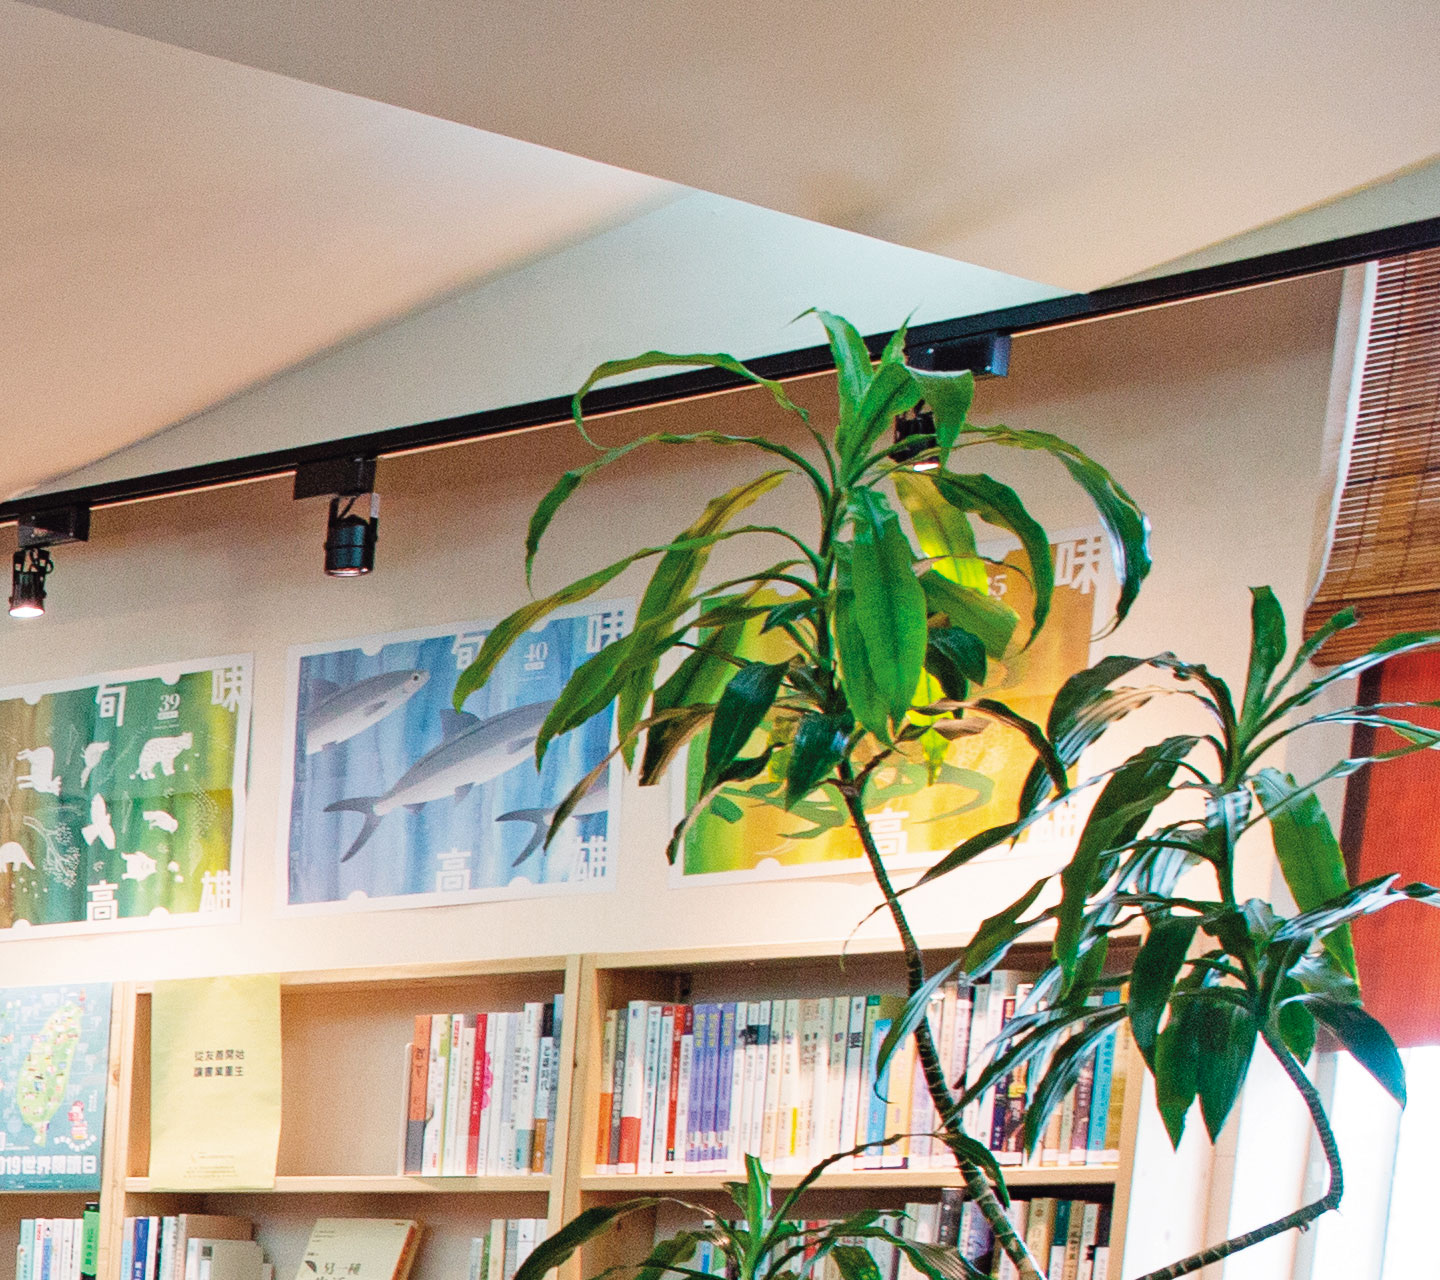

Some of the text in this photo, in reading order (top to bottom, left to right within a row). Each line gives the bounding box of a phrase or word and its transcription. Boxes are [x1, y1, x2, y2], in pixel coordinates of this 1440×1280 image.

[1055, 537, 1102, 594] 味
[95, 666, 243, 727] 旬 味
[160, 694, 180, 711] 39
[437, 848, 472, 891] 高
[87, 880, 118, 921] 高
